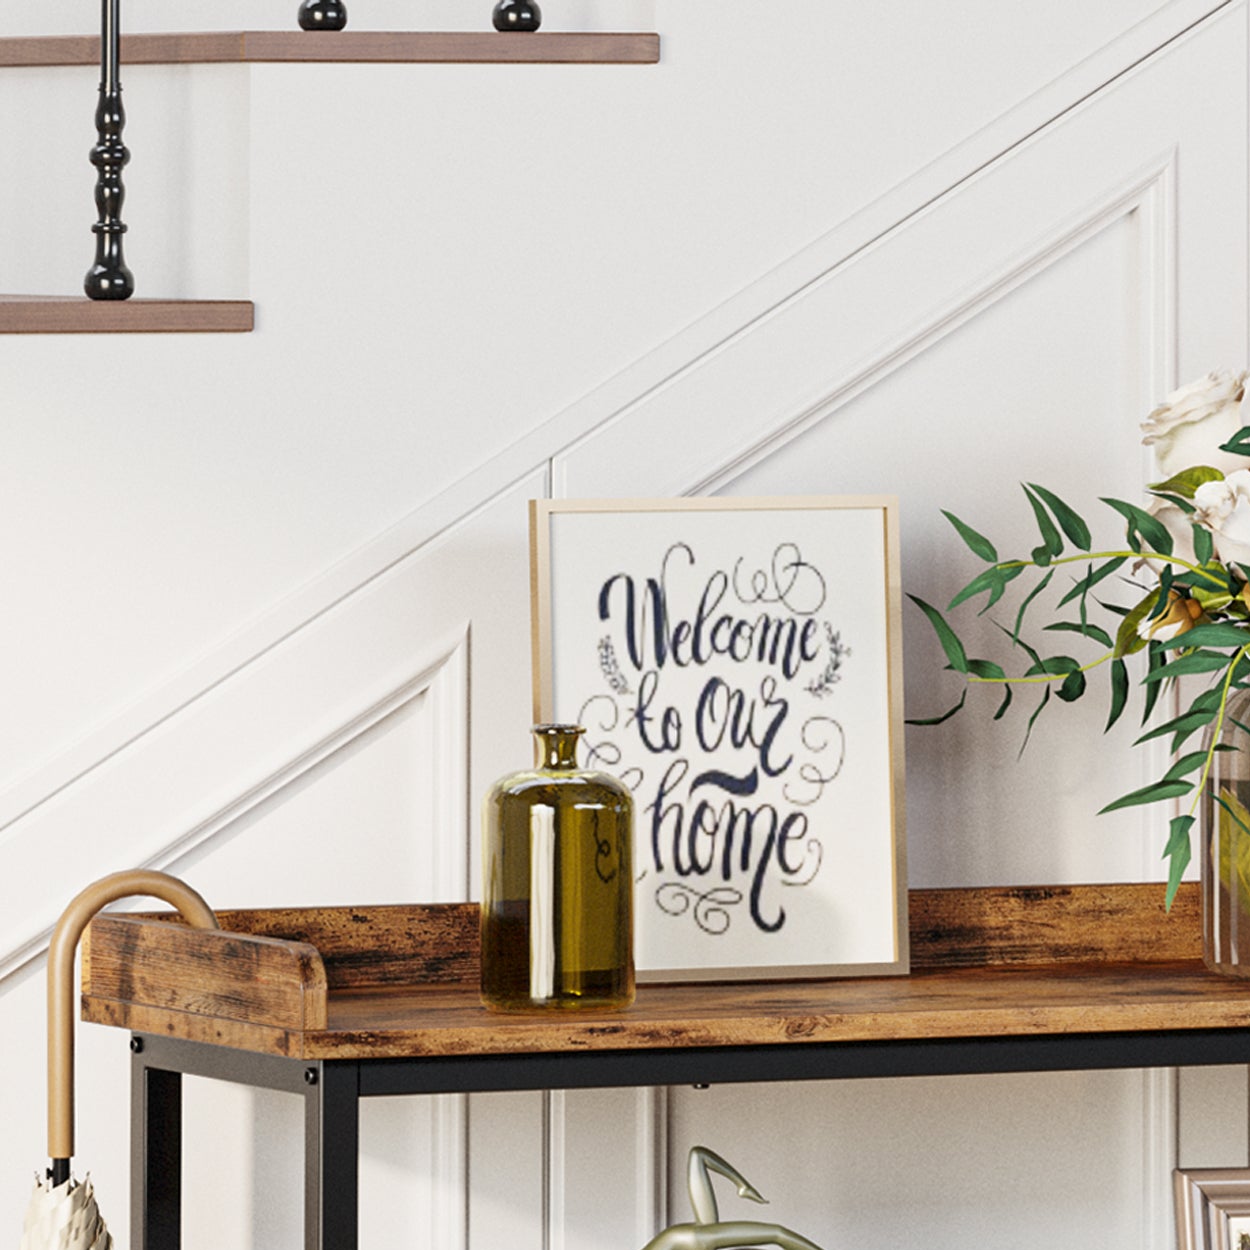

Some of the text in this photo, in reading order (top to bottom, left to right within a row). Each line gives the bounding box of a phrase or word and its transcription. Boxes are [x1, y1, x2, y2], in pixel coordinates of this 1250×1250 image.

[598, 542, 818, 681] Welcome
[627, 670, 683, 754] to
[645, 759, 809, 933] home
